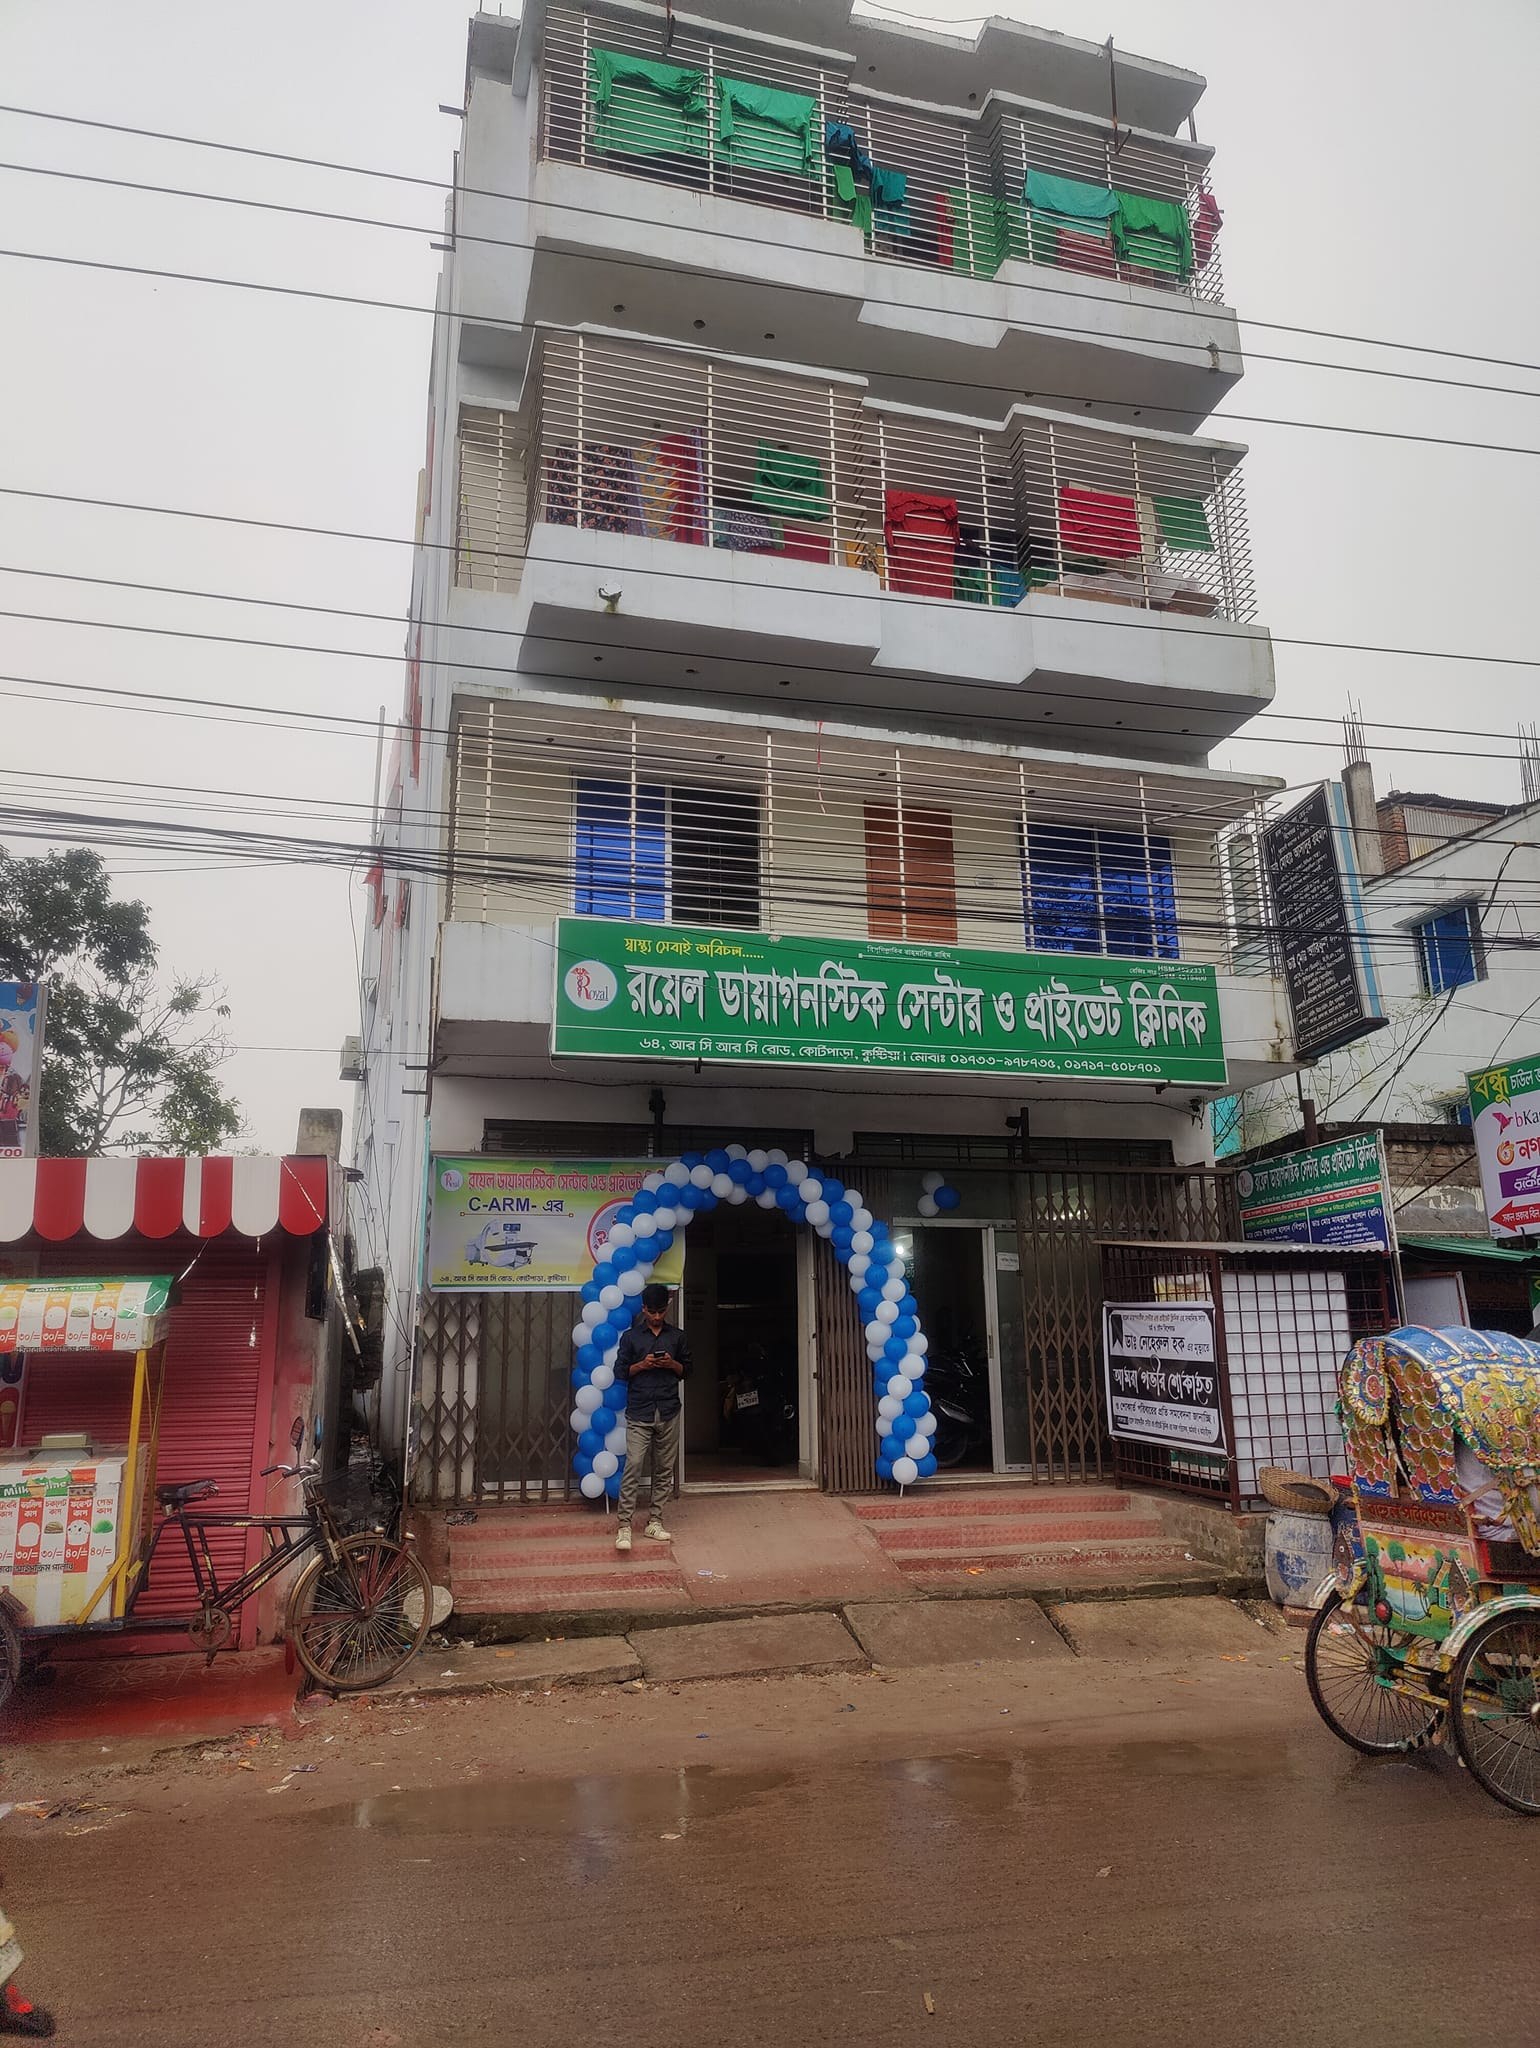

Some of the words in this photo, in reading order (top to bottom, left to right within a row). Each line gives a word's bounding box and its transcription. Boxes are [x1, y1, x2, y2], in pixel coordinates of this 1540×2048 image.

[624, 937, 652, 955] স্বাস্থ্য
[655, 937, 693, 955] সেবাই
[624, 964, 710, 1022] রয়েল
[714, 960, 889, 1032] ডায়াগনস্টিক
[897, 967, 985, 1037] সেন্টার
[992, 991, 1016, 1032] ও
[1024, 975, 1124, 1048] প্রাইভেট
[1127, 981, 1208, 1049] ক্লিনিক
[639, 1037, 666, 1051] ৬৪,
[669, 1039, 696, 1051] আর
[699, 1038, 713, 1052] সি
[715, 1042, 742, 1053] আর
[745, 1040, 758, 1054] সি
[761, 1044, 796, 1057] রোড,
[1064, 1059, 1162, 1073] ০১৭১৭-৫০৮৭০১
[1470, 1067, 1511, 1108] বন্ধু
[1510, 1069, 1535, 1090] চাউল
[1514, 1109, 1540, 1128] bKa
[542, 1200, 565, 1212] এর
[1124, 1335, 1137, 1350] ডাঃ
[1170, 1336, 1186, 1354] হক
[1112, 1366, 1140, 1394] আমরা
[1141, 1354, 1166, 1397] গভীর
[1167, 1370, 1214, 1406] শোকাহত
